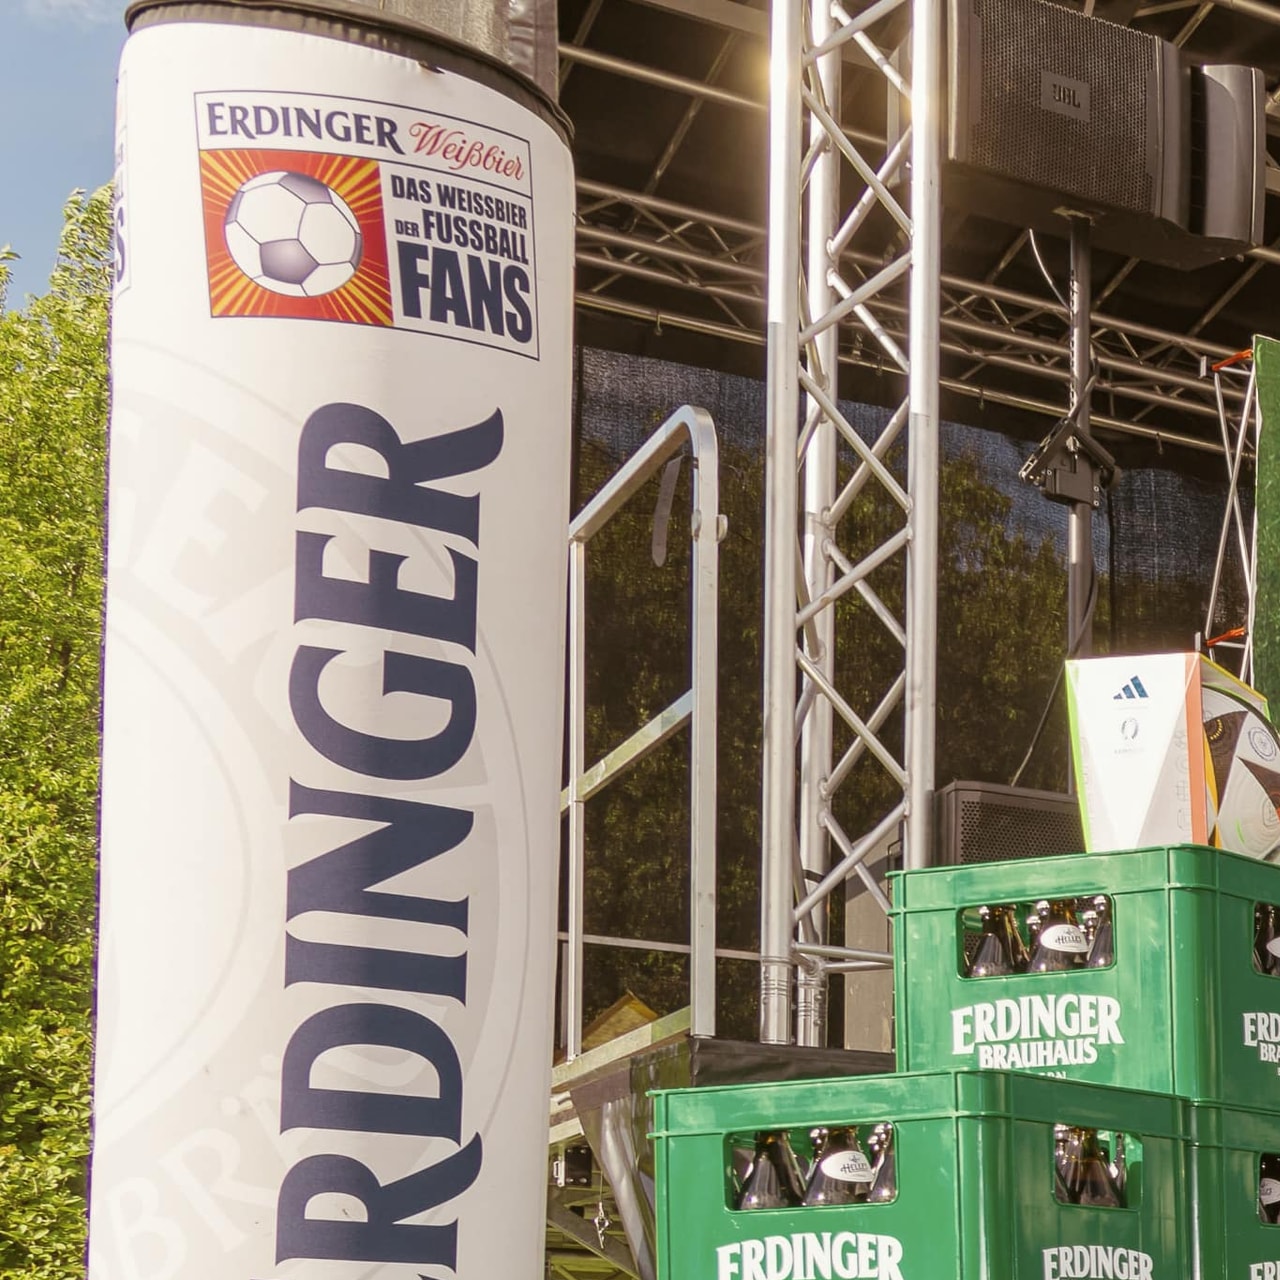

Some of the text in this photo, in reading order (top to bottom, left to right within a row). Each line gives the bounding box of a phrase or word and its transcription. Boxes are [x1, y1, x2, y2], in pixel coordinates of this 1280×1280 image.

[1053, 83, 1081, 109] JBL
[206, 102, 525, 181] ERDINGER Weißbier
[391, 174, 527, 230] DAS WEISSBIER
[394, 208, 530, 266] DER FUSSBALL
[396, 239, 533, 344] FANS
[950, 993, 1124, 1055] ERDINGER
[979, 1037, 1098, 1071] BRAUHAUS
